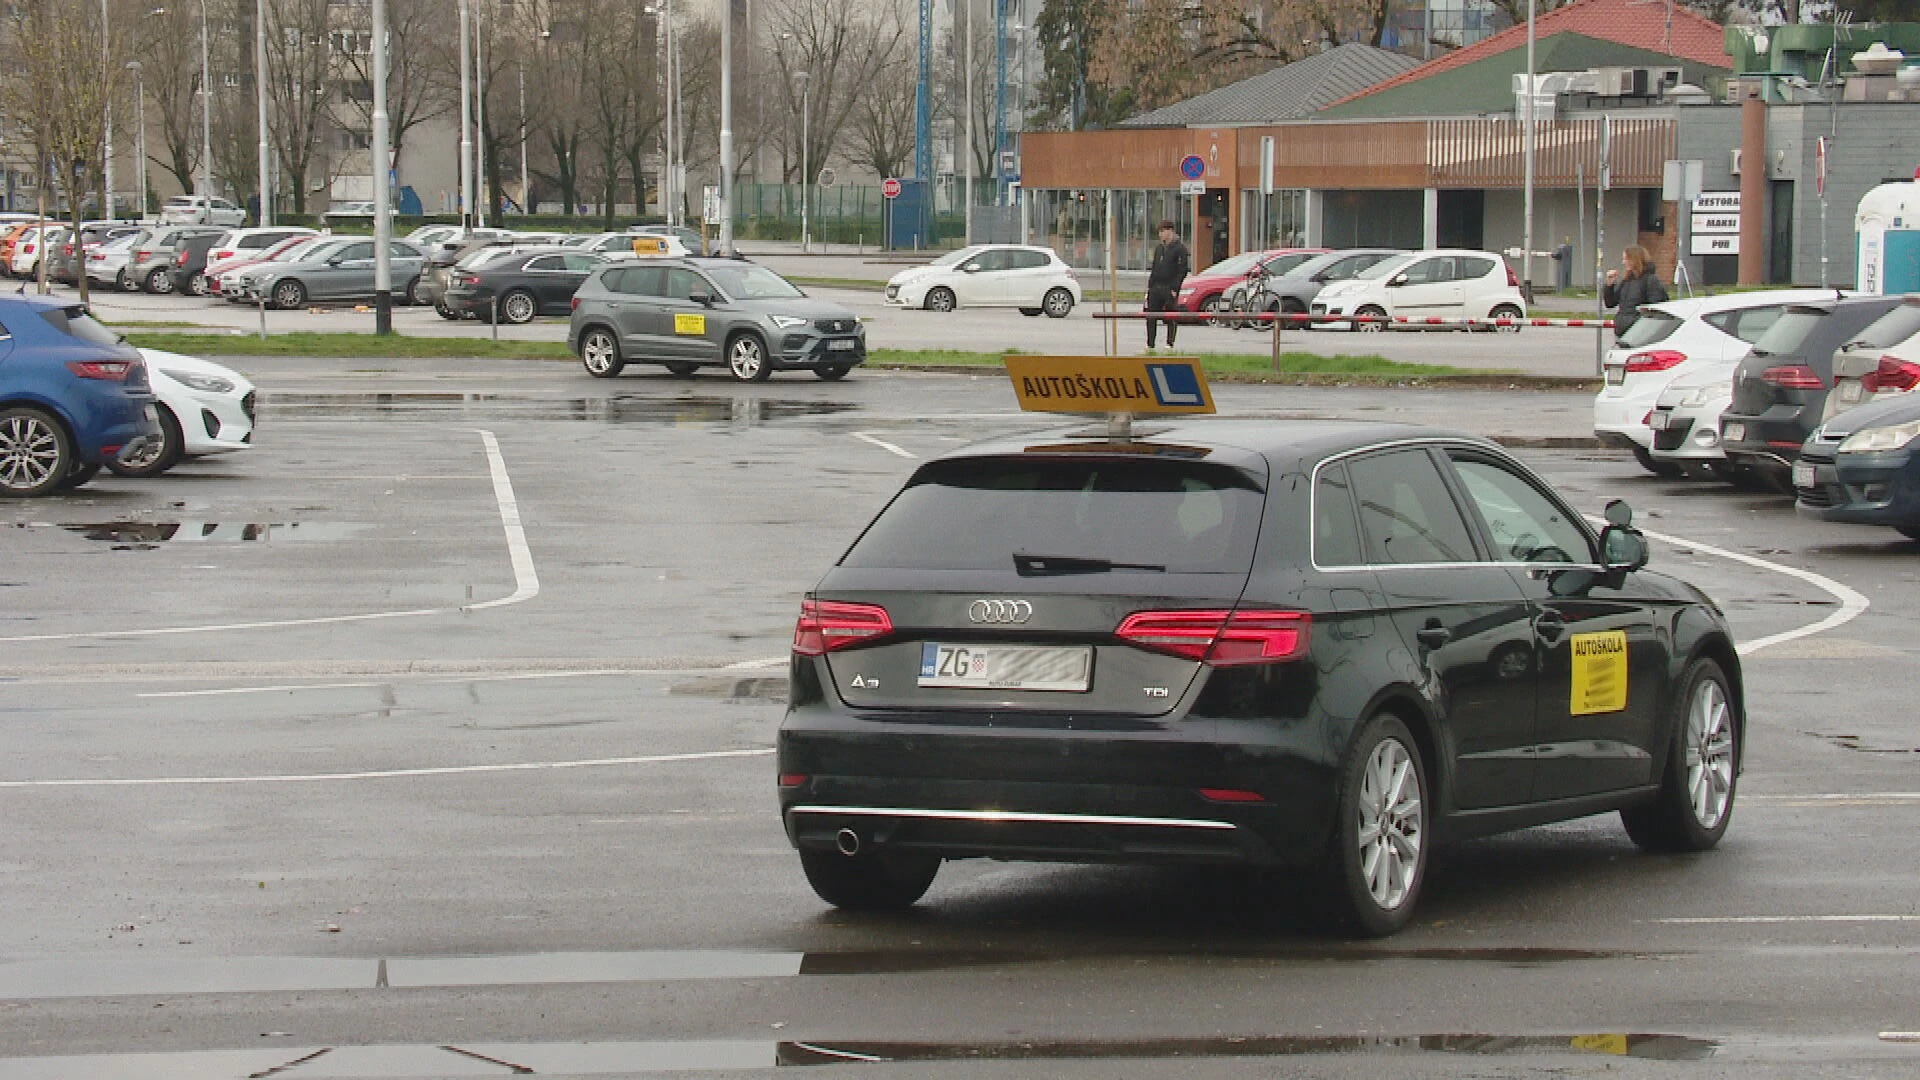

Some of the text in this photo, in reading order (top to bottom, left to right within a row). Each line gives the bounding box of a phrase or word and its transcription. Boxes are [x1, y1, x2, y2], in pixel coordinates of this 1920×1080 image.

[883, 183, 899, 192] STOP
[1698, 197, 1740, 206] RESTORA
[1706, 219, 1736, 227] MAKSI
[1712, 240, 1730, 248] PUB
[1023, 367, 1198, 402] AUTOŠKOLA L
[1576, 637, 1624, 656] AUTOŠKOLA
[939, 648, 969, 677] ZG
[851, 674, 880, 688] A3
[1143, 687, 1168, 698] TDI
